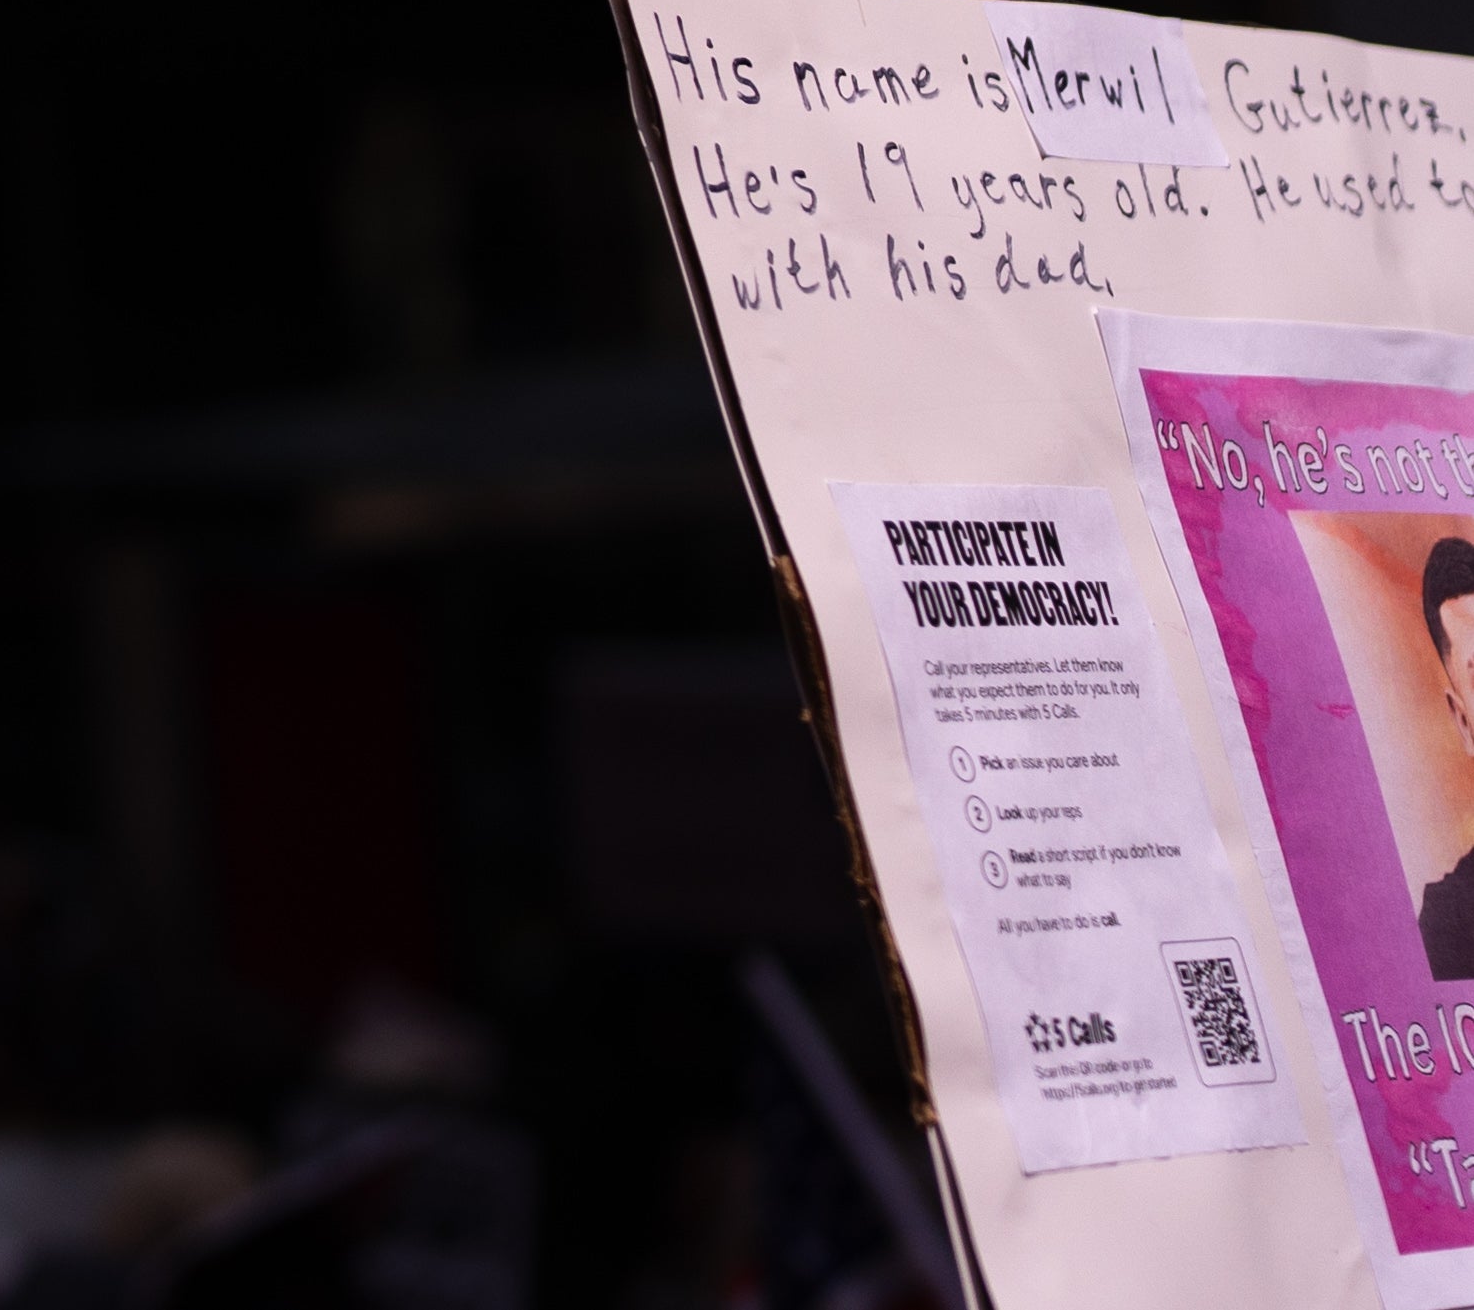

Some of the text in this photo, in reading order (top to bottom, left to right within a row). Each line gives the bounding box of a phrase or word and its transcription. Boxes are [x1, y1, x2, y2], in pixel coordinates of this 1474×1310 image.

[653, 12, 761, 105] His
[793, 61, 940, 112] name
[960, 53, 1009, 112] is
[1006, 36, 1175, 125] Merwil
[693, 143, 818, 219] He's
[856, 141, 924, 213] 19
[951, 171, 1085, 240] years
[1115, 163, 1209, 219] old.
[1240, 155, 1302, 223] He
[1312, 152, 1415, 218] used
[732, 233, 851, 310] with
[886, 233, 967, 301] his
[1262, 420, 1365, 495] he’s
[1366, 439, 1449, 500] not
[882, 520, 1066, 567] PARTICIPATE IN
[902, 581, 1120, 628] YOUR DEMOCRACY!
[924, 659, 944, 676] Call
[946, 662, 968, 679] your
[1054, 657, 1070, 673] Let
[1072, 658, 1097, 673] them
[1098, 657, 1124, 673] know
[930, 683, 956, 699] what
[958, 686, 977, 702] you
[979, 683, 1014, 701] expect
[1015, 683, 1045, 697] them
[1046, 682, 1058, 696] to
[1060, 680, 1074, 695] do
[1075, 680, 1089, 695] for
[1111, 680, 1120, 694] It
[1121, 680, 1141, 698] only
[935, 706, 964, 722] takes
[965, 706, 973, 721] 5
[975, 706, 1018, 721] minutes
[1019, 704, 1041, 720] with
[1042, 704, 1051, 719] 5
[980, 755, 1005, 770] Pick
[1007, 757, 1020, 769] an
[1021, 755, 1044, 769] issue
[1046, 757, 1064, 773] you
[1065, 755, 1089, 768] care
[1091, 752, 1120, 768] about
[974, 806, 984, 822] 2
[996, 804, 1022, 820] Look
[1040, 806, 1061, 822] your
[990, 861, 1000, 877] 3
[1008, 848, 1036, 863] Read
[1045, 847, 1070, 862] short
[1109, 847, 1129, 864] you
[1156, 843, 1181, 857] know
[1052, 1012, 1118, 1048] 5 Calls
[1341, 1005, 1436, 1083] The
